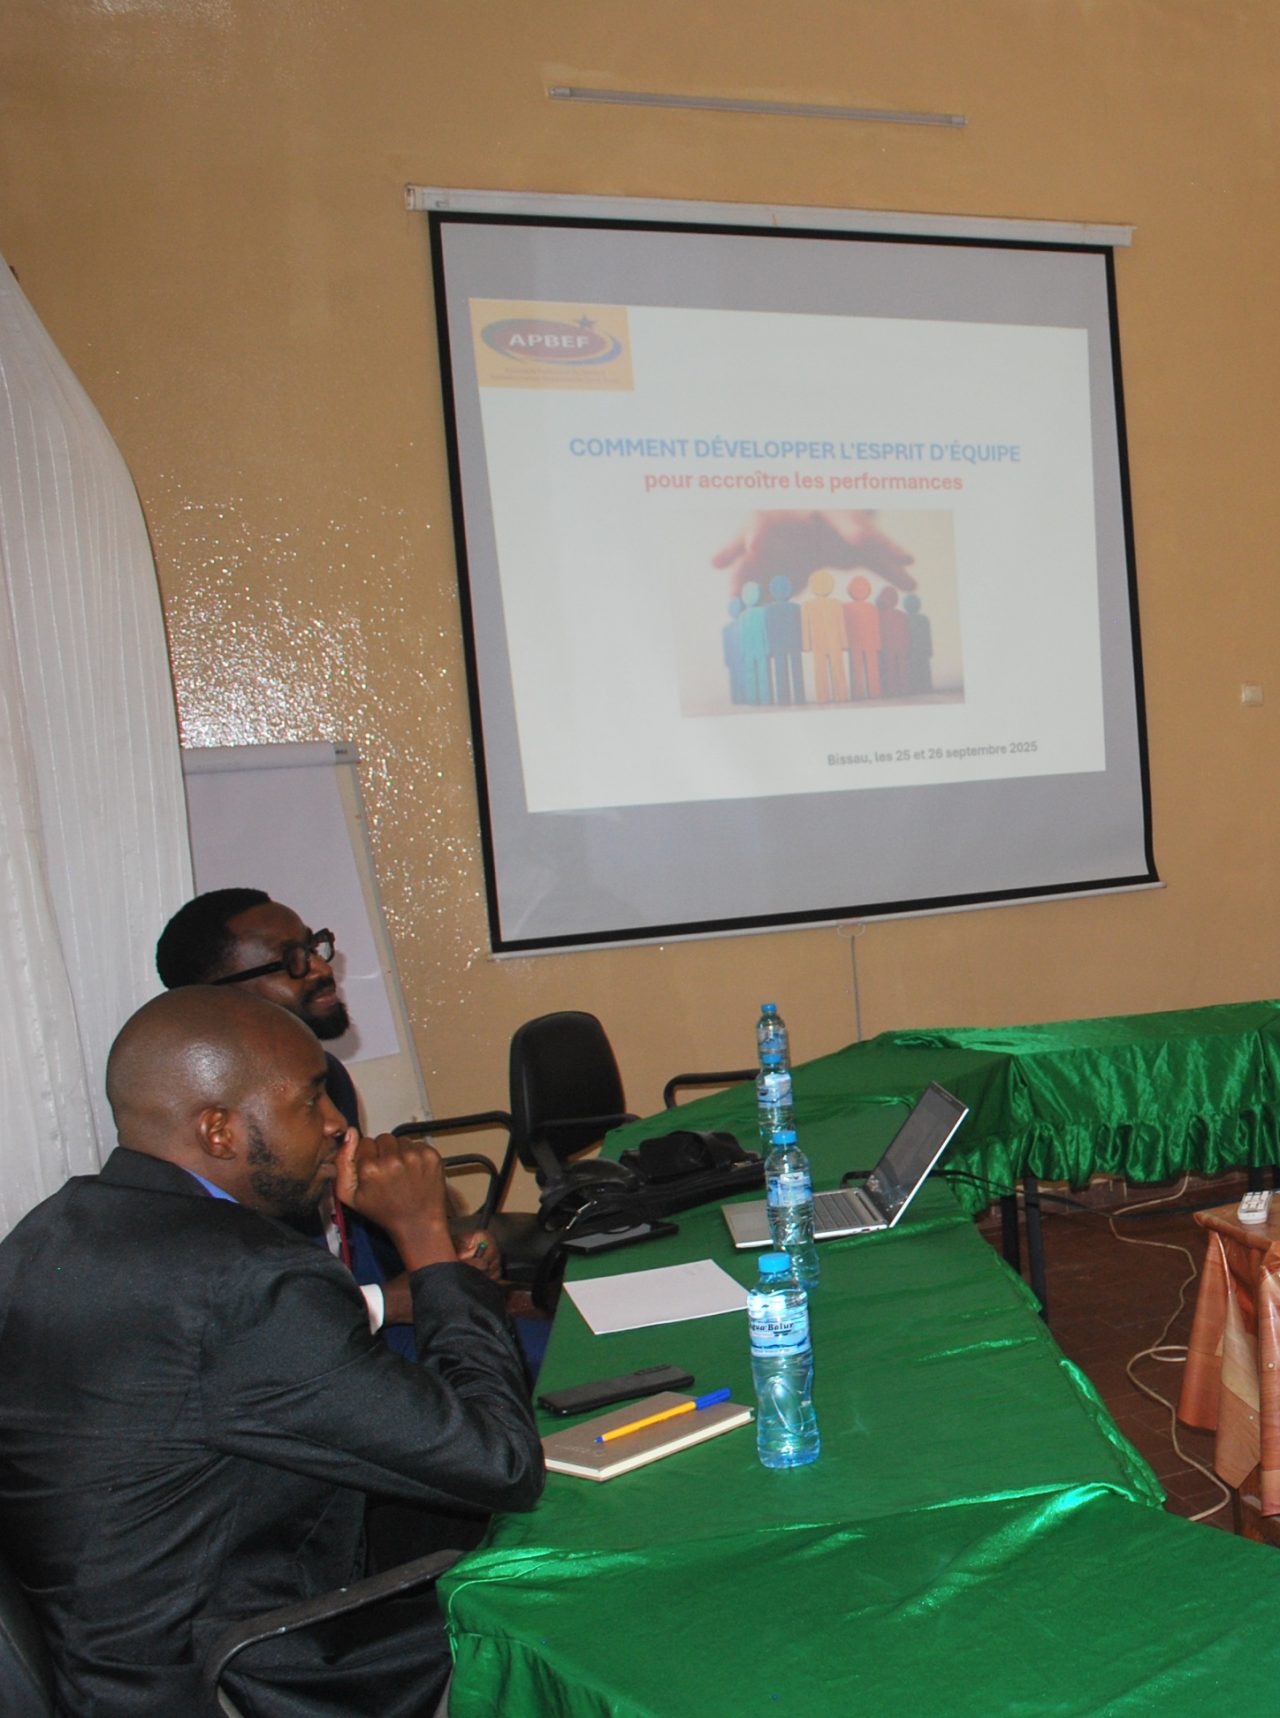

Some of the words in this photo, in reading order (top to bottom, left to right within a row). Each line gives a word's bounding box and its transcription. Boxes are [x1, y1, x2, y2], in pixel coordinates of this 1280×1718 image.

[510, 334, 589, 348] APBEF
[569, 437, 689, 457] COMMENT
[694, 434, 836, 460] DÉVELOPPER
[839, 441, 926, 462] L'ESPRIT
[930, 440, 1022, 465] D'ÉQUIPE
[644, 473, 693, 492] pour
[698, 470, 790, 489] accroître
[794, 472, 825, 490] les
[829, 472, 964, 493] performances
[827, 754, 873, 765] Bissau,
[875, 752, 893, 763] les
[896, 750, 911, 761] 25
[913, 750, 926, 760] et
[929, 748, 943, 759] 26
[945, 743, 1007, 760] septembre
[1009, 740, 1039, 753] 2025
